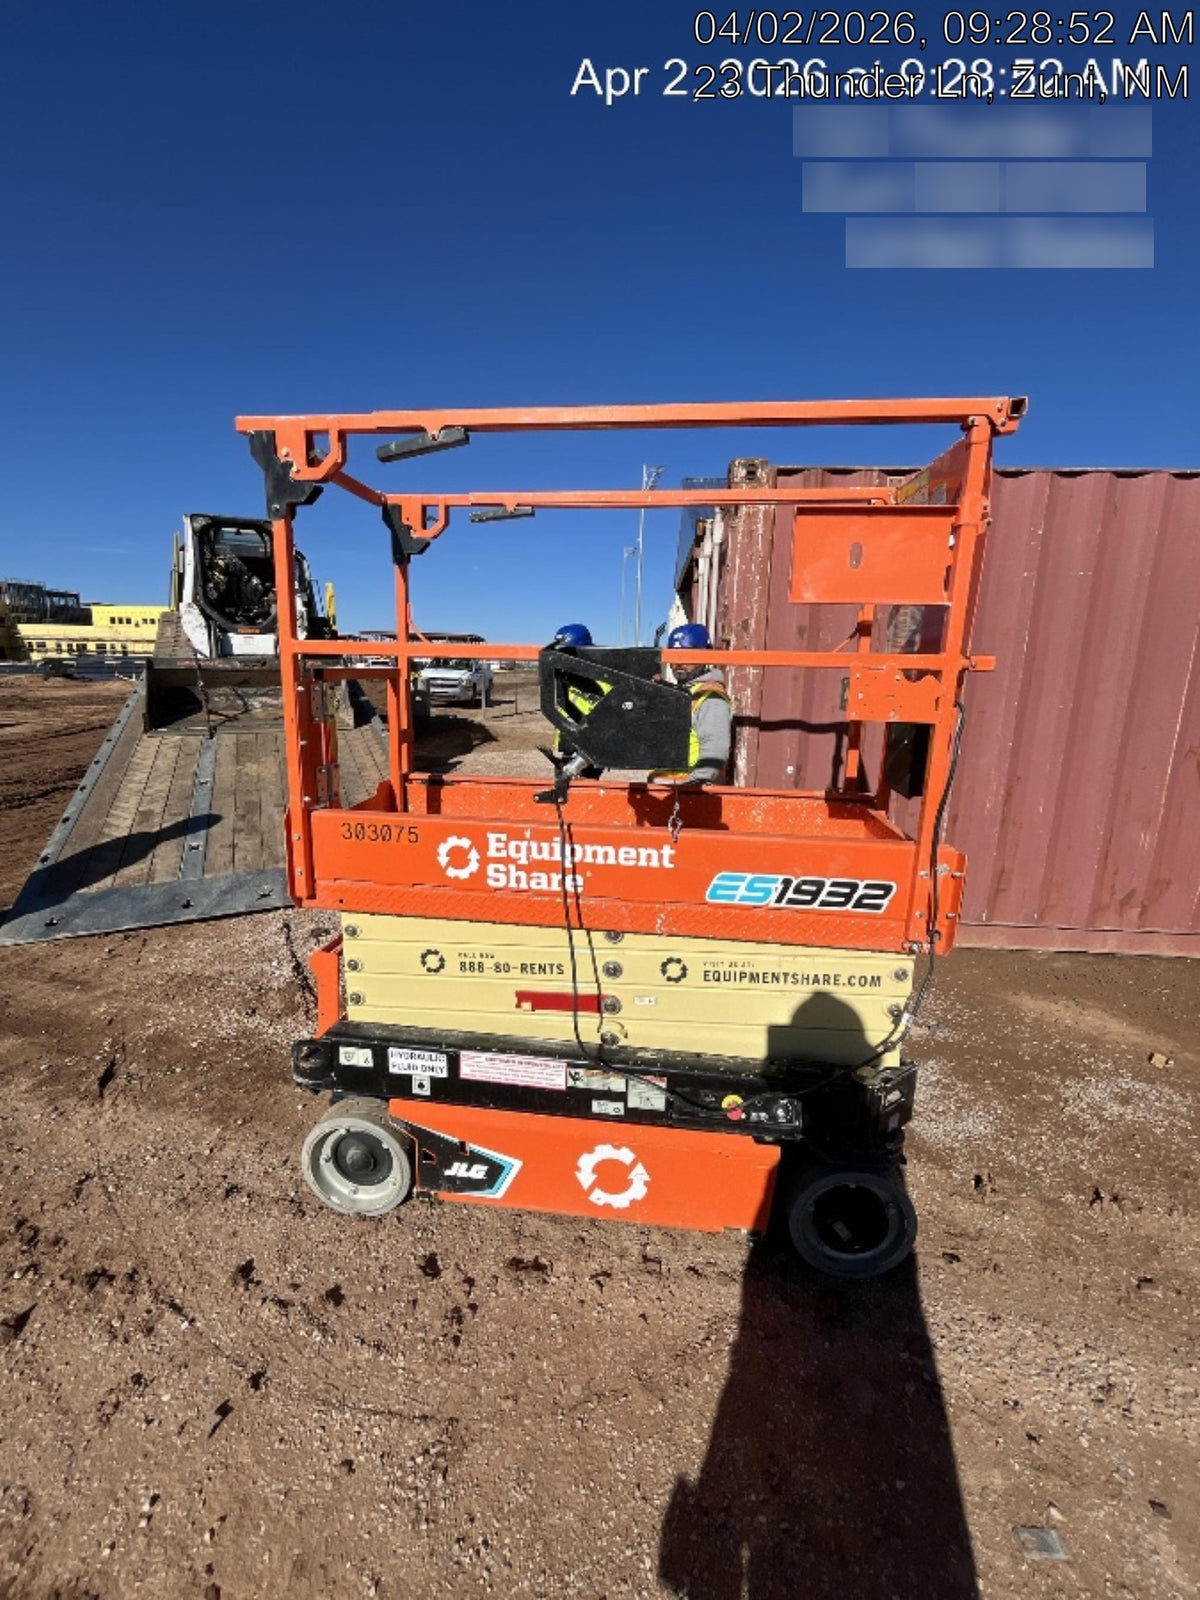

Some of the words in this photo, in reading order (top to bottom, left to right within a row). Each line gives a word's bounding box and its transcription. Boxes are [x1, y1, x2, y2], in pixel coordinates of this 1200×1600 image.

[341, 822, 419, 843] 303075
[487, 831, 676, 869] Equipment
[487, 863, 585, 893] Share
[706, 872, 897, 912] ES1932
[459, 961, 565, 975] 888-80-RENTS
[703, 970, 881, 988] EQUIPMENTSHARE.COM
[421, 1064, 445, 1074] ONLY
[443, 1162, 489, 1180] JLG
